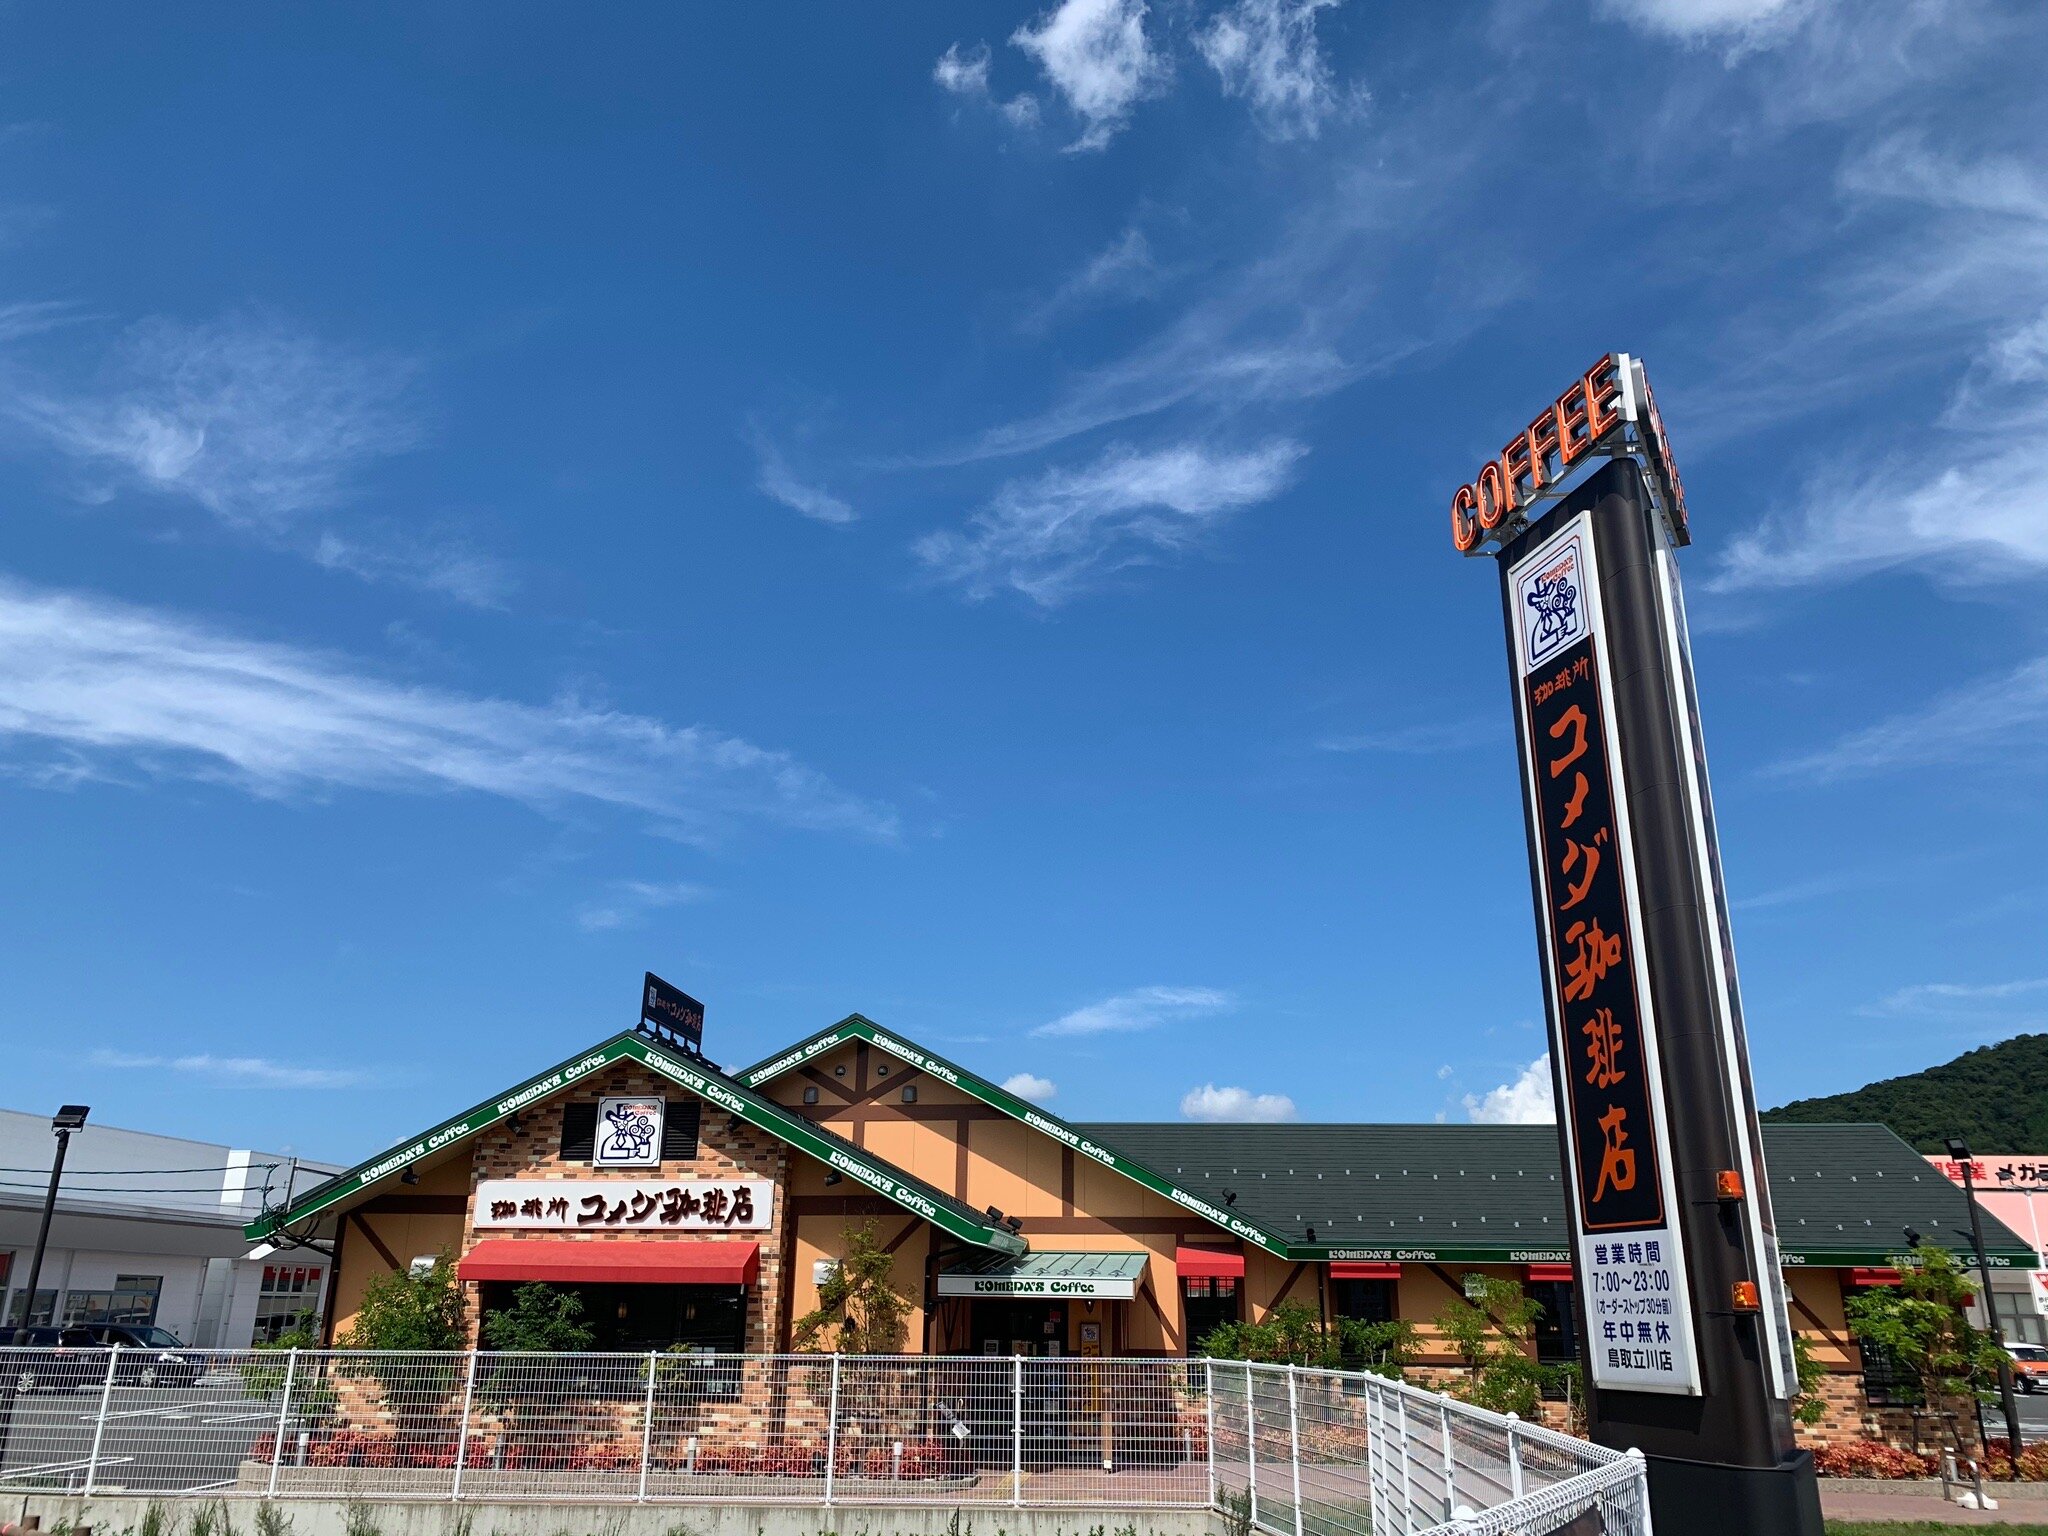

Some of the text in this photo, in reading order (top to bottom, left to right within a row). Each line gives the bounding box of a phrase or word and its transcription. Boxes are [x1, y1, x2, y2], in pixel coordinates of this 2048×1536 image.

[1452, 352, 1627, 551] COFFEE
[1534, 656, 1589, 706] 珈琲所
[1550, 704, 1636, 1203] コメダ珈琲店
[644, 1051, 745, 1112] KOMEDA'S Coffee
[750, 1034, 839, 1084] KOMEDA'S Coffee
[872, 1033, 958, 1083] KOMEDA'S Coffee
[497, 1054, 606, 1114] KOMEDA'S Coffee
[360, 1123, 470, 1184] KOMEDA'S Coffee
[1025, 1111, 1115, 1165] KOMEDA'S Coffee
[491, 1185, 754, 1226] 珈琲所 コメダ珈琲店
[829, 1151, 937, 1217] KOMEDA'S Coffee
[1171, 1188, 1267, 1245] KOMEDA'S Coffee
[1328, 1250, 1436, 1260] KOMEDA'S Coffee
[1595, 1241, 1660, 1264] 営業時間
[1780, 1254, 1805, 1263] ffee
[974, 1280, 1095, 1293] KOMEDA'S Coffee
[1603, 1320, 1671, 1344] 年中無休
[1608, 1348, 1673, 1371] 鳥取立川店
